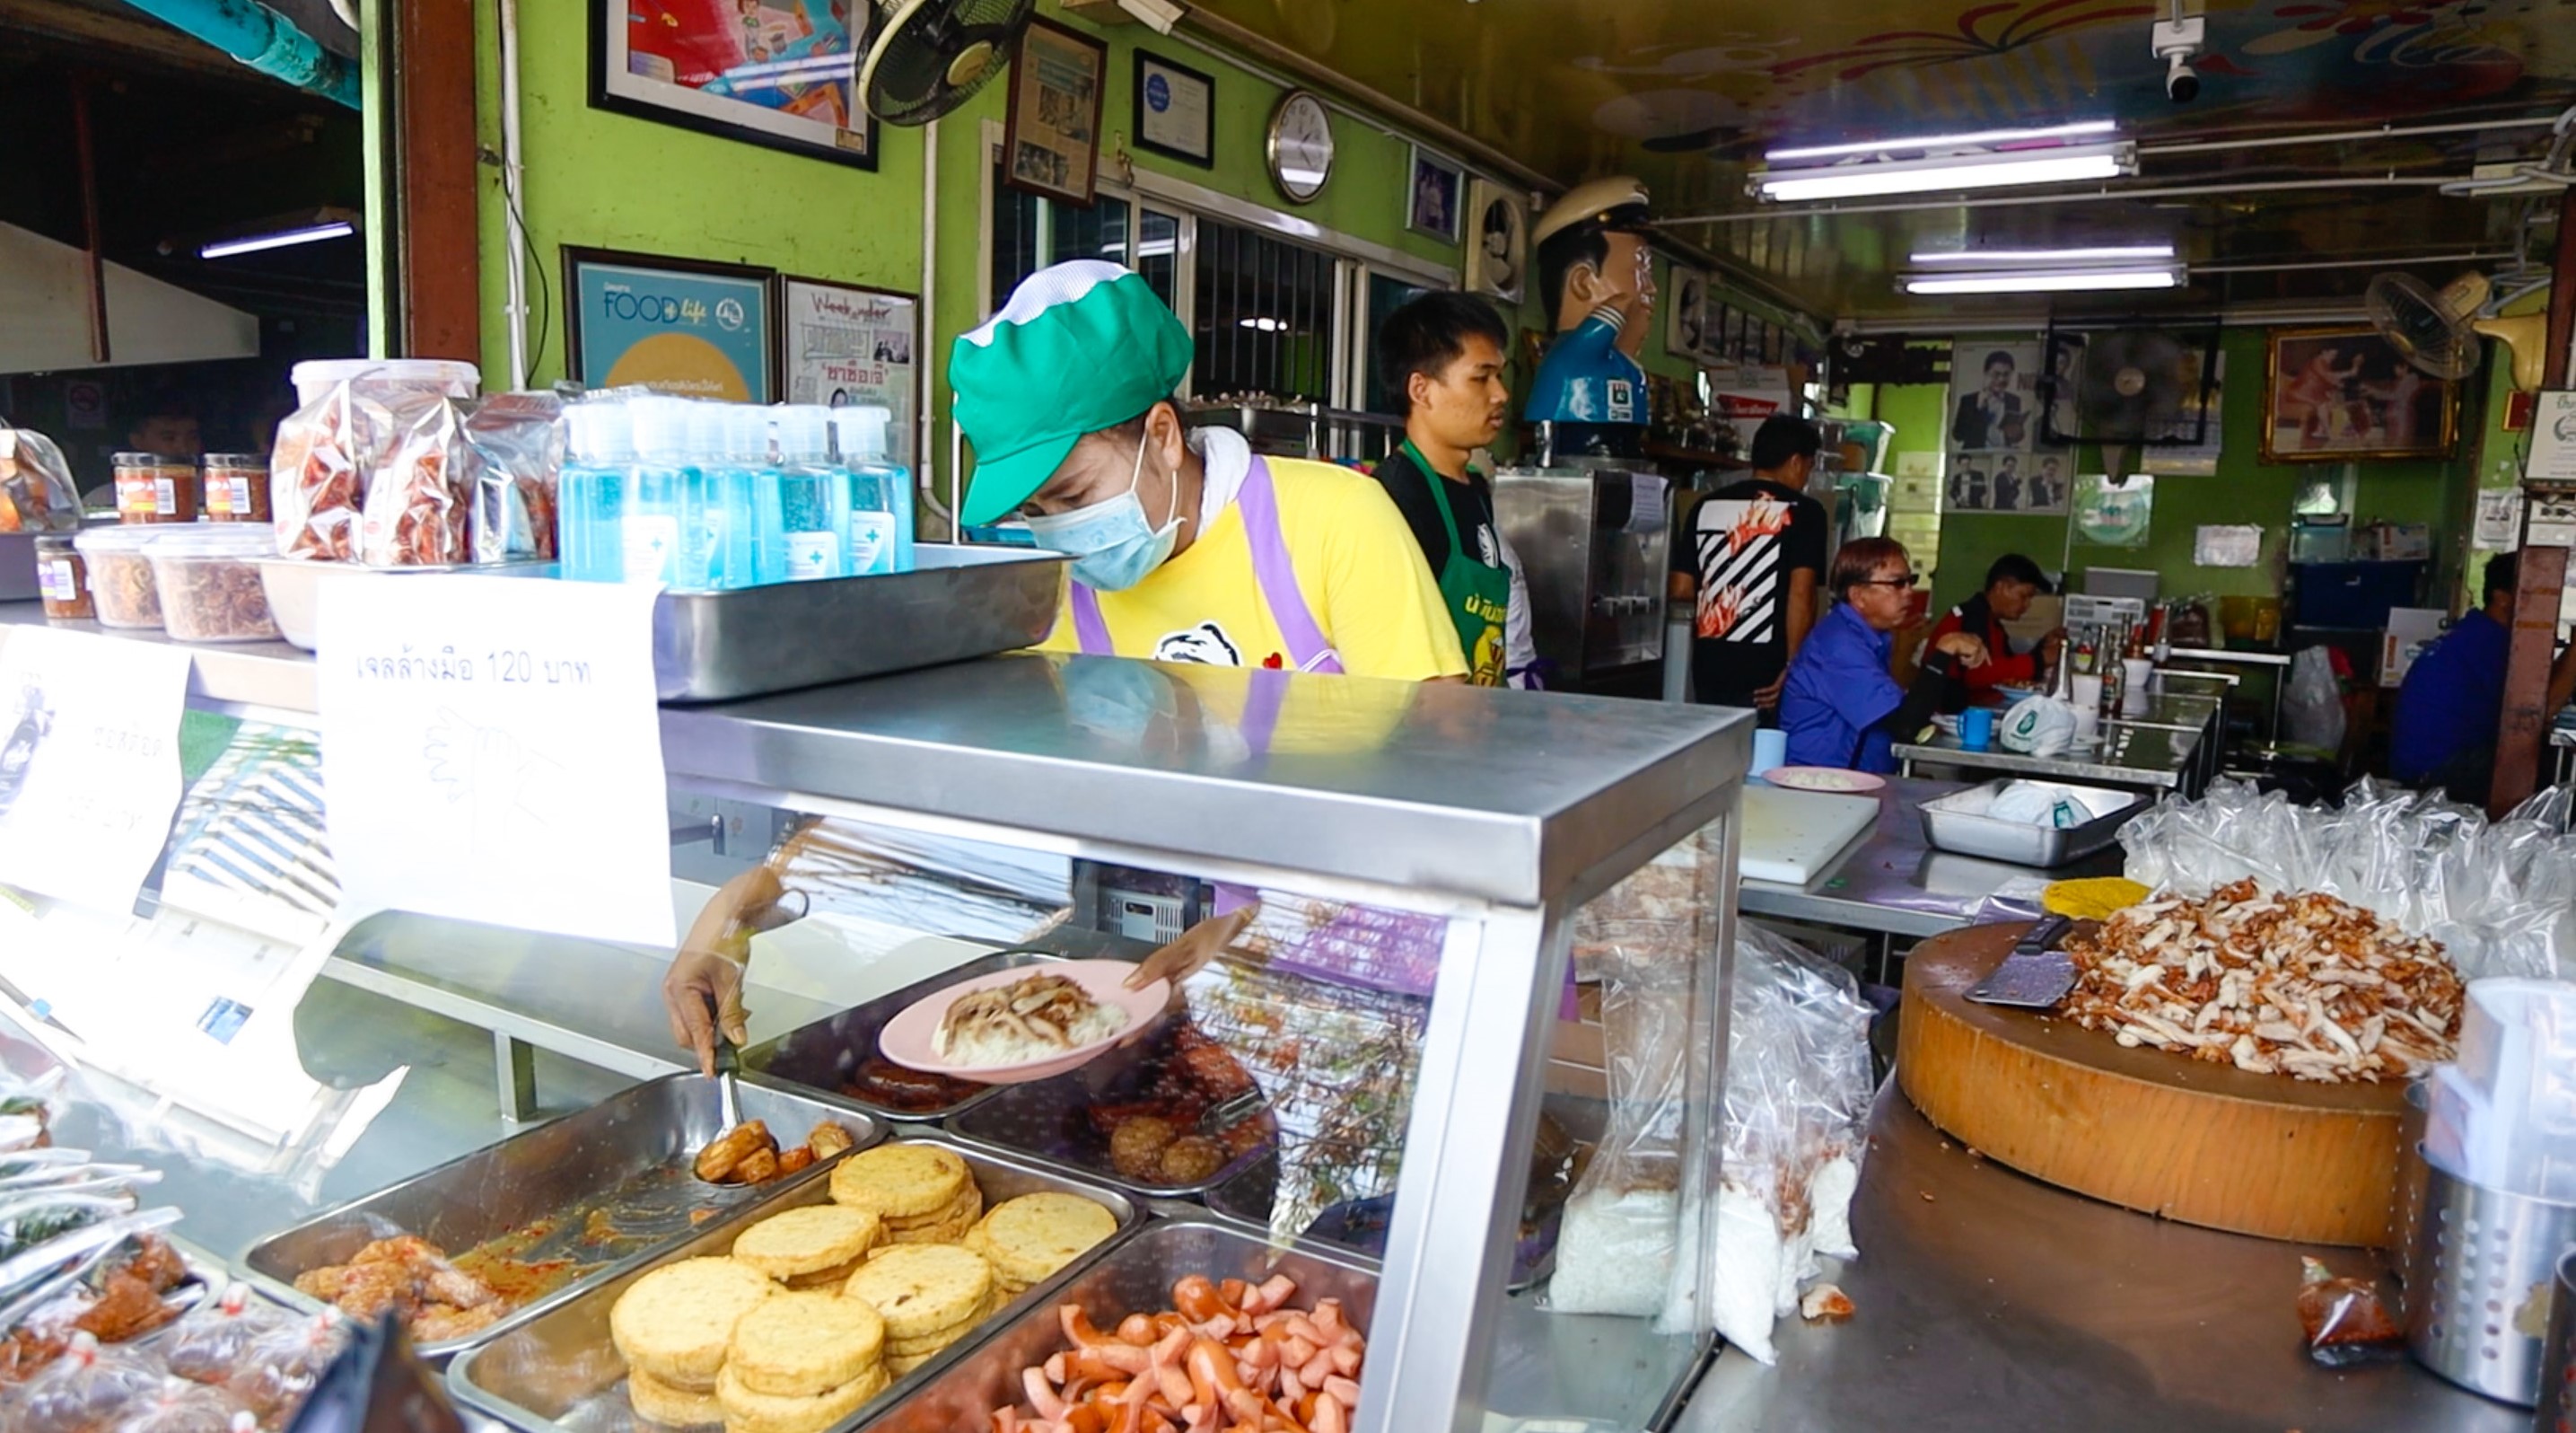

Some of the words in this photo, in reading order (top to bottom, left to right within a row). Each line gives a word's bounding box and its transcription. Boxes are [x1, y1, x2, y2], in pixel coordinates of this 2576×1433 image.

[604, 291, 681, 324] FOOD
[356, 643, 474, 681] เจลล้างมือ
[487, 650, 531, 683] 120
[544, 660, 592, 685] บาท
